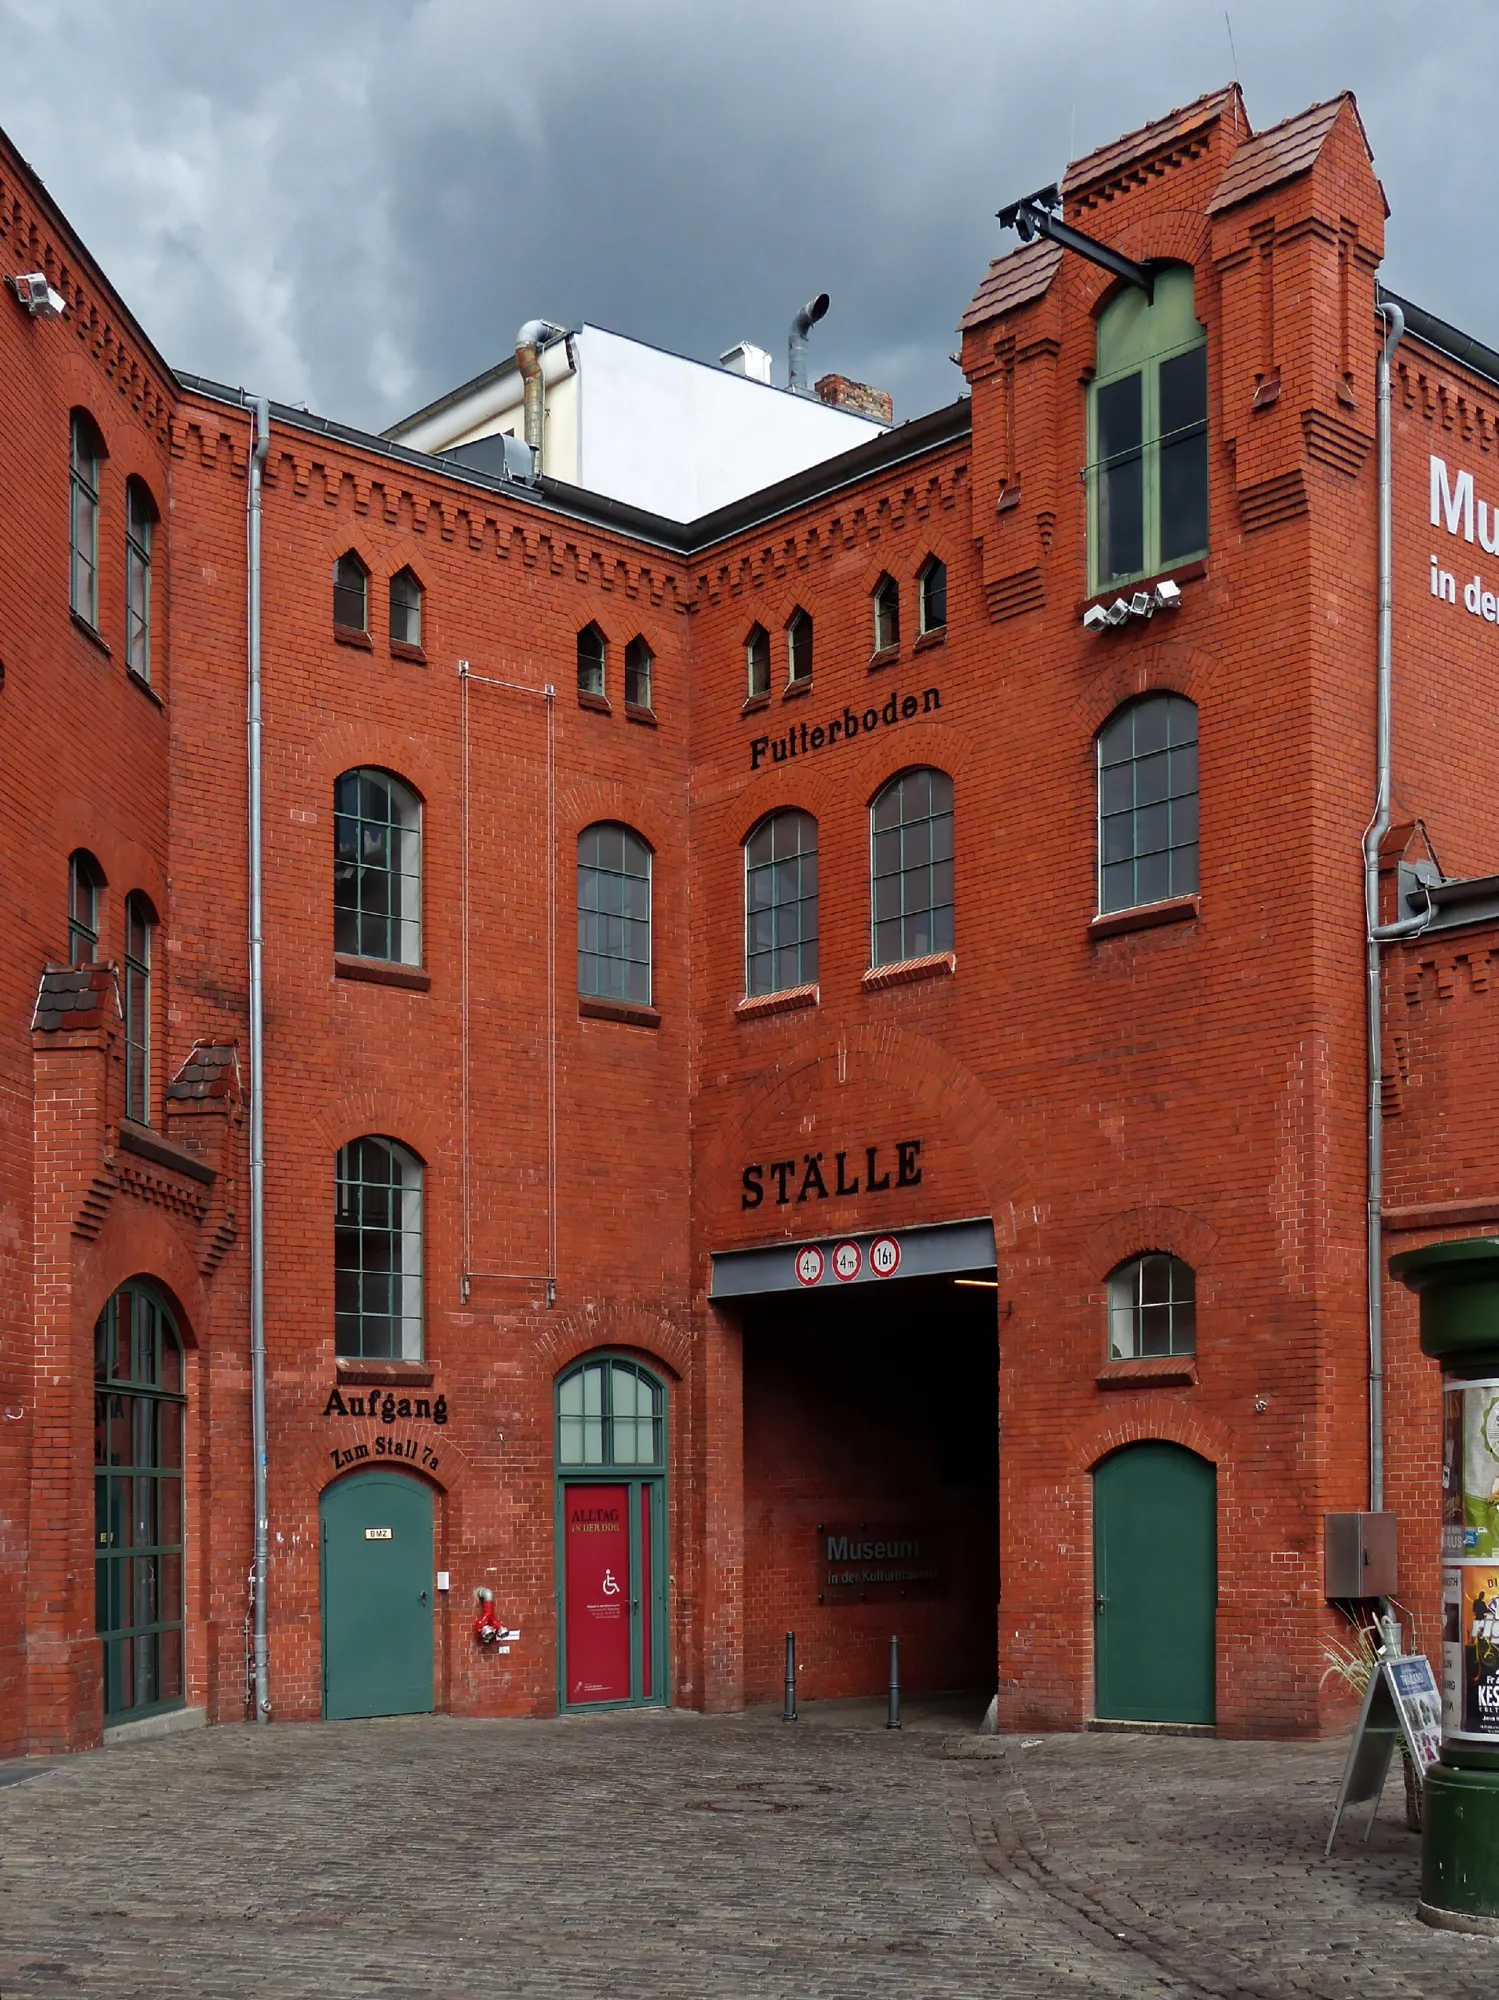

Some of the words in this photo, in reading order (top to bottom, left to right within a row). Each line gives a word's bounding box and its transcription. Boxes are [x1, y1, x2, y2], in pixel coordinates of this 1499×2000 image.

[1430, 555, 1456, 604] in
[1464, 576, 1499, 625] de
[750, 687, 942, 770] Futterboden
[741, 1140, 922, 1210] STÄLLE
[323, 1388, 448, 1425] Aufgang
[330, 1444, 370, 1470] Zum
[375, 1436, 418, 1460] Stall
[422, 1446, 440, 1471] 7a
[572, 1508, 619, 1522] ALLTAG
[572, 1524, 581, 1532] IN
[583, 1523, 600, 1532] DER
[601, 1523, 620, 1532] DDR
[827, 1536, 919, 1560] Museum
[827, 1571, 839, 1584] in
[841, 1570, 859, 1583] der
[862, 1568, 939, 1582] Kulturbrauerei
